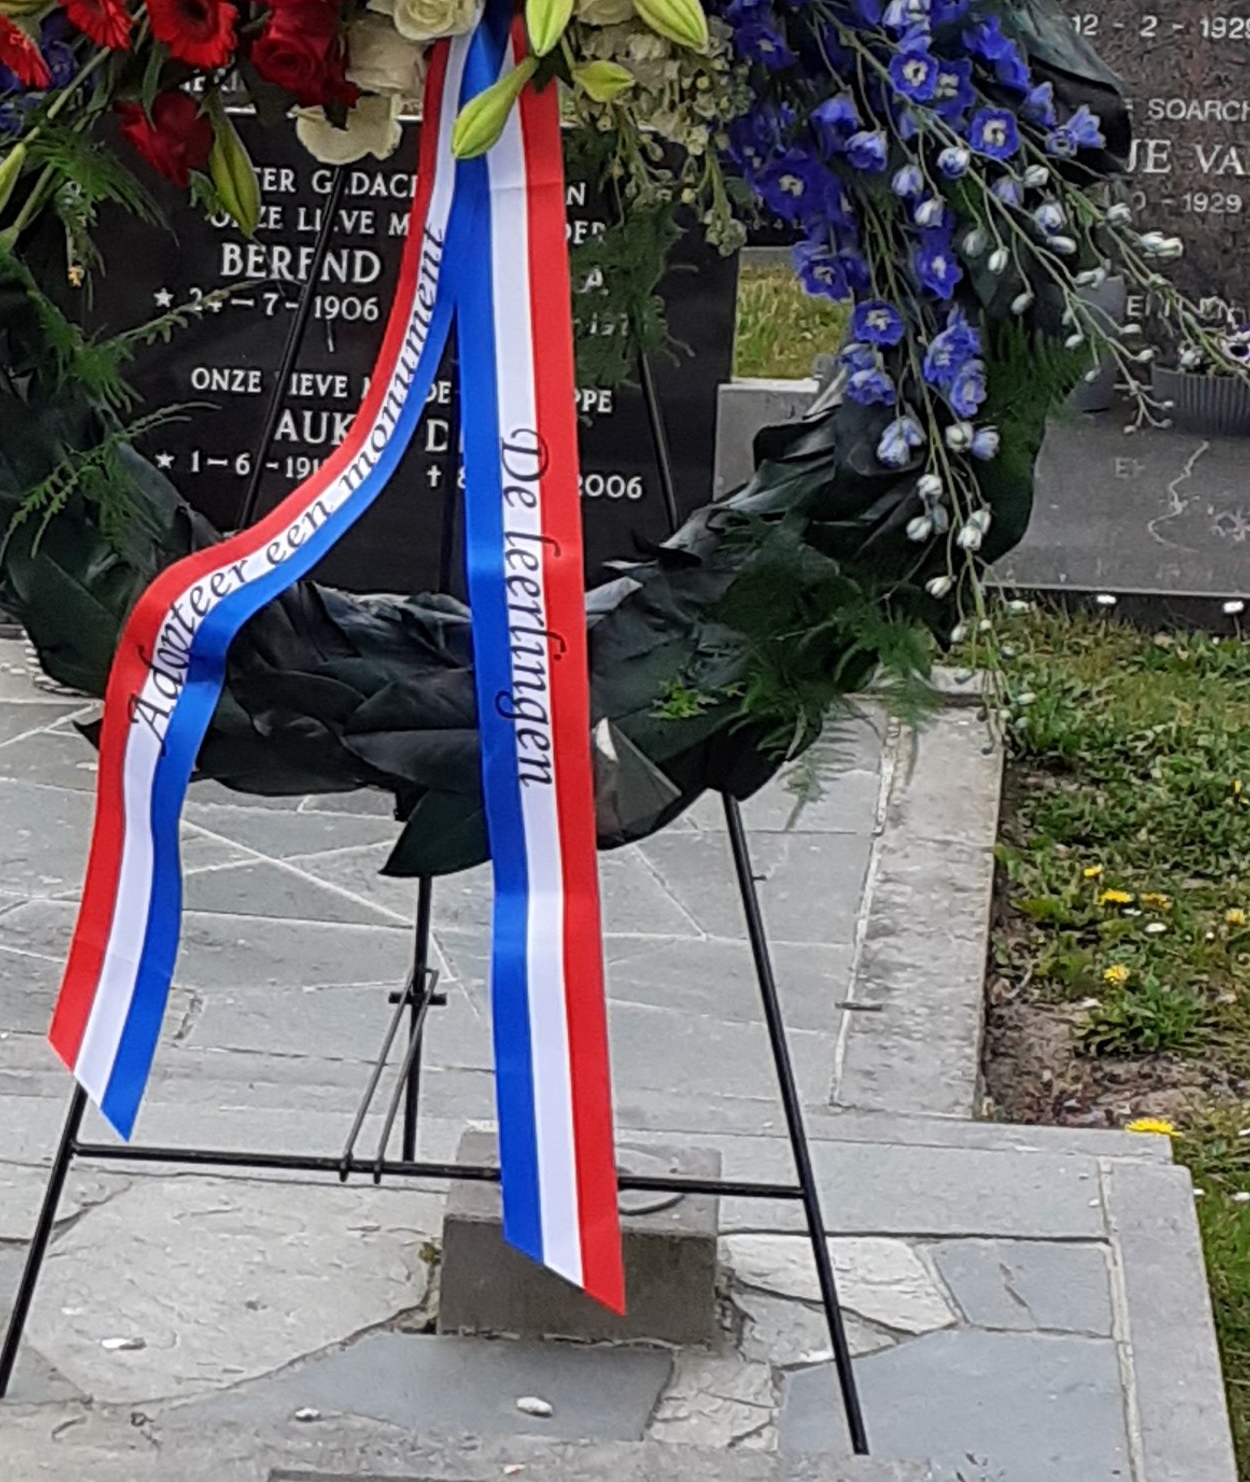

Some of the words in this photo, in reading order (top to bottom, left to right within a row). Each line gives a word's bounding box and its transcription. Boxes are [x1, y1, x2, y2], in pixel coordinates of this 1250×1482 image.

[297, 207, 375, 234] LIVE
[314, 295, 380, 320] 1906
[191, 368, 262, 393] ONZE
[277, 371, 348, 398] IEVE
[128, 559, 250, 757] Adopteer
[265, 499, 334, 566] een
[340, 226, 447, 492] monument
[502, 427, 549, 508] De
[495, 530, 566, 788] leerlingen
